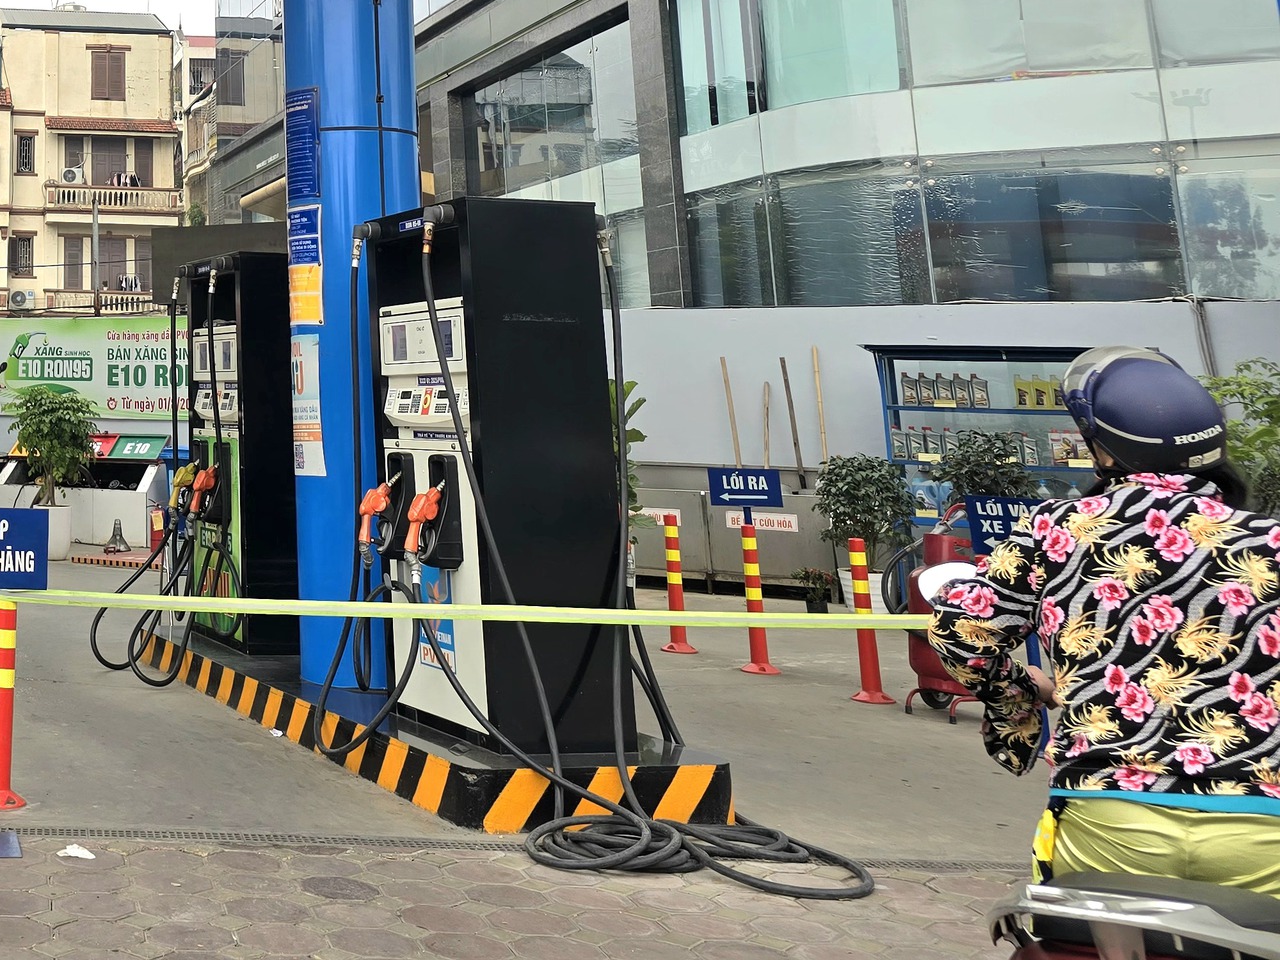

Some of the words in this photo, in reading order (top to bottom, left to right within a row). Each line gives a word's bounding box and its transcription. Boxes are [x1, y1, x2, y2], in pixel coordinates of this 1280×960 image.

[107, 330, 120, 340] Cửa
[122, 330, 140, 342] hàng
[141, 331, 159, 342] xăng
[161, 327, 172, 340] dầ
[176, 330, 189, 340] PVO
[107, 344, 131, 361] BÁN
[134, 344, 167, 361] XĂNG
[174, 348, 189, 361] SIN
[18, 359, 41, 378] E10
[44, 359, 91, 378] RON95
[107, 364, 147, 387] E10
[121, 396, 132, 410] Từ
[134, 396, 155, 412] ngày
[1173, 424, 1223, 445] HONDA
[122, 442, 151, 454] E10
[722, 471, 744, 490] LỐI
[747, 475, 769, 490] RA
[975, 498, 1003, 516] LỐI
[980, 519, 1005, 534] XE
